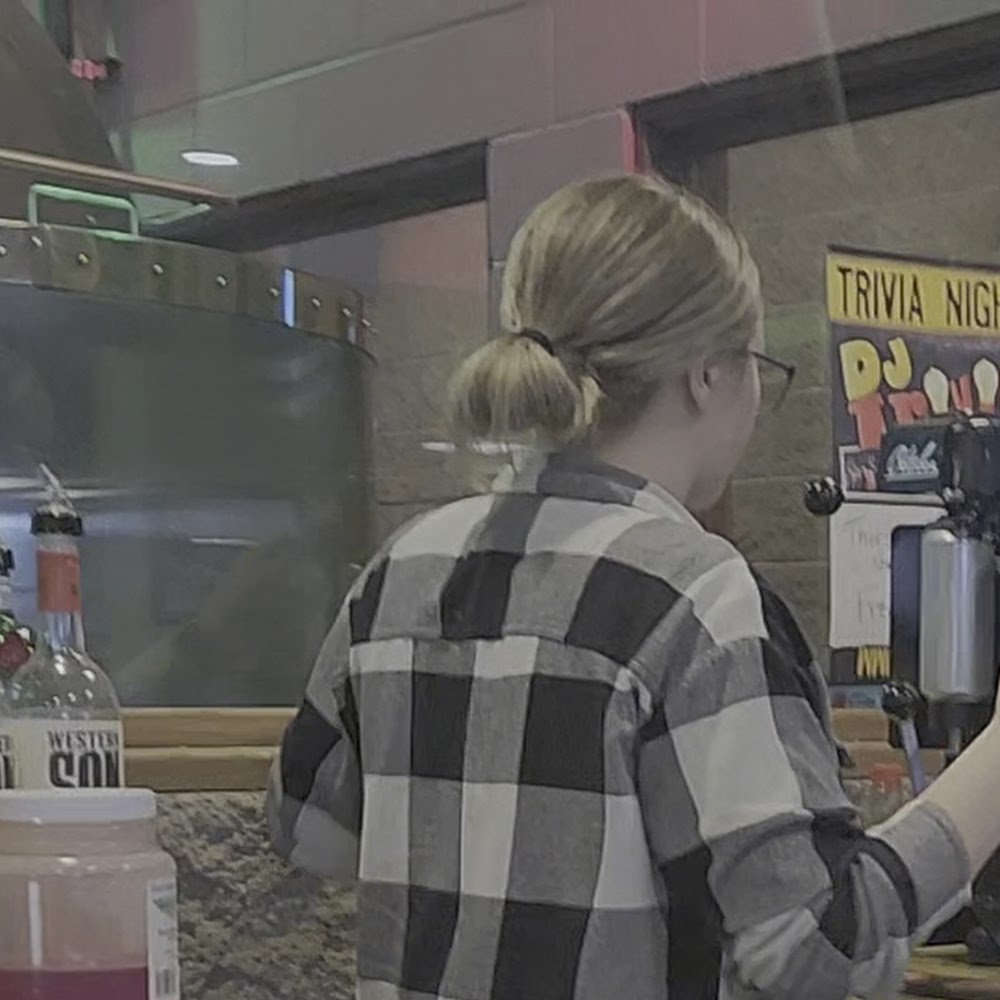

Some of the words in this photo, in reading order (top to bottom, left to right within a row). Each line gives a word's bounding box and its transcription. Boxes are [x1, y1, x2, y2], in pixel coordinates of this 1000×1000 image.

[837, 266, 924, 324] TRIVIA
[839, 336, 912, 400] DJ
[49, 751, 120, 788] SON
